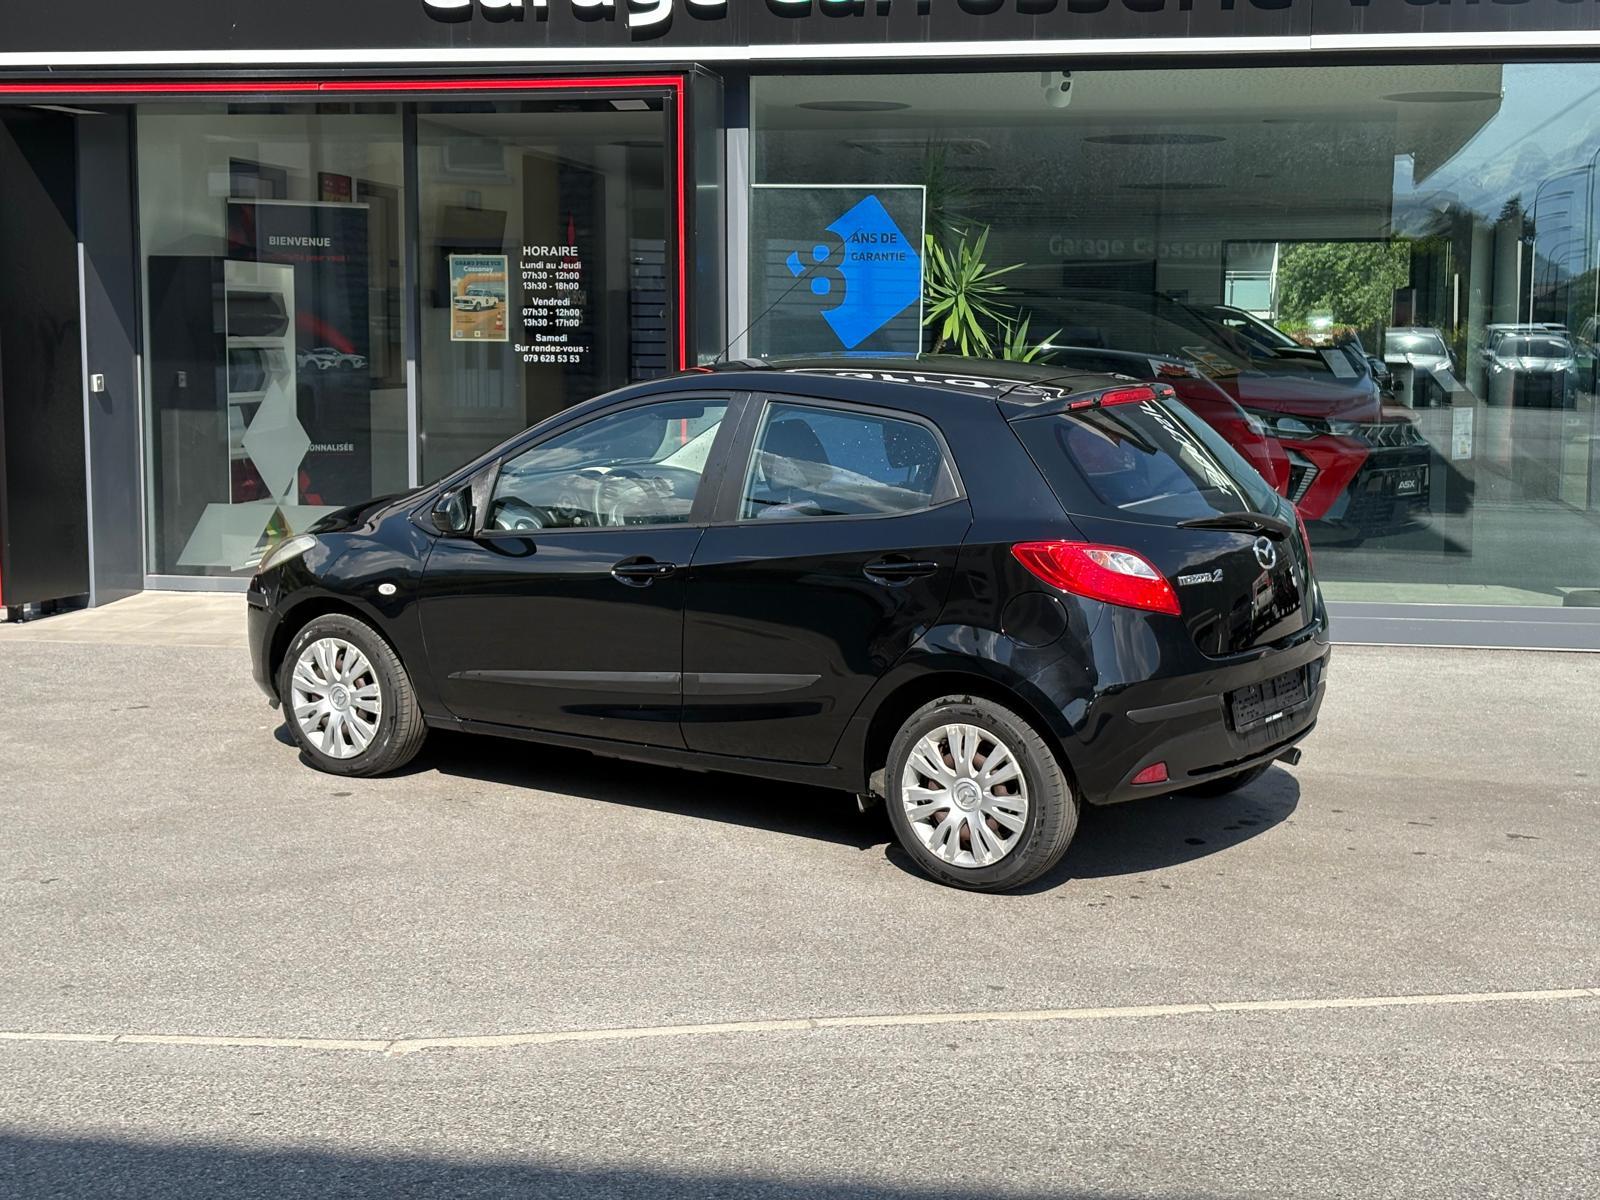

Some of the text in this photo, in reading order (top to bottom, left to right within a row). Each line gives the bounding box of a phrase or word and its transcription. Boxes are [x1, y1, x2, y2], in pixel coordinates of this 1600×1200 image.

[268, 236, 332, 247] BIENVENUE
[851, 232, 897, 244] ANS DE
[1048, 234, 1125, 259] Garage
[522, 246, 578, 256] HORAIRE
[851, 251, 906, 262] GARANTIE
[520, 261, 544, 269] Lundi
[558, 261, 581, 269] Jeudi
[522, 272, 547, 280] 07h30
[555, 272, 580, 280] 12h00
[522, 282, 547, 290] 13h30
[555, 282, 580, 290] 18h00
[532, 297, 570, 306] Vendredi
[522, 308, 547, 316] 07h30
[555, 308, 580, 316] 12h00
[523, 319, 547, 327] 13h30
[555, 319, 580, 327] 17h00
[536, 334, 568, 342] Samedi
[514, 344, 529, 352] Sur
[531, 344, 584, 352] rendez-vous
[523, 355, 580, 363] 079 628 53 53
[307, 442, 354, 452] ONNALISÉE
[1398, 480, 1415, 489] ASX
